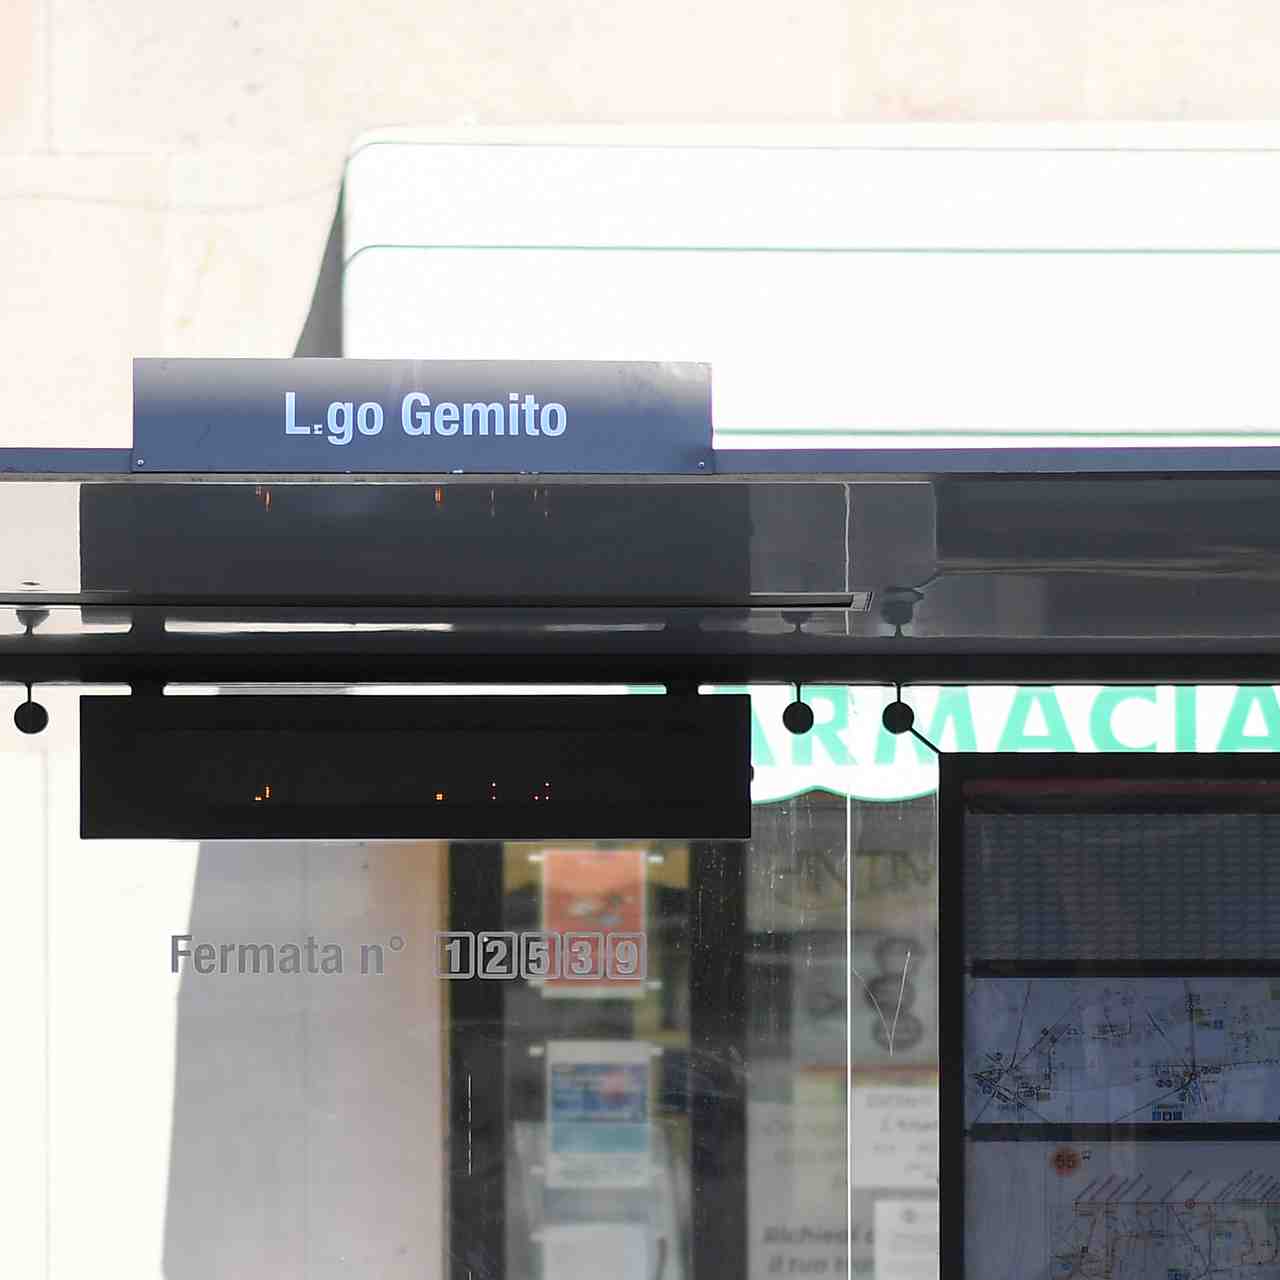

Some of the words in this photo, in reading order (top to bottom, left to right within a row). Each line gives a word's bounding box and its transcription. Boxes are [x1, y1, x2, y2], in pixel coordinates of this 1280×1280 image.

[284, 391, 385, 446] L.go
[400, 391, 568, 437] Gemito
[170, 934, 345, 975] Fermata
[441, 937, 641, 977] 12539
